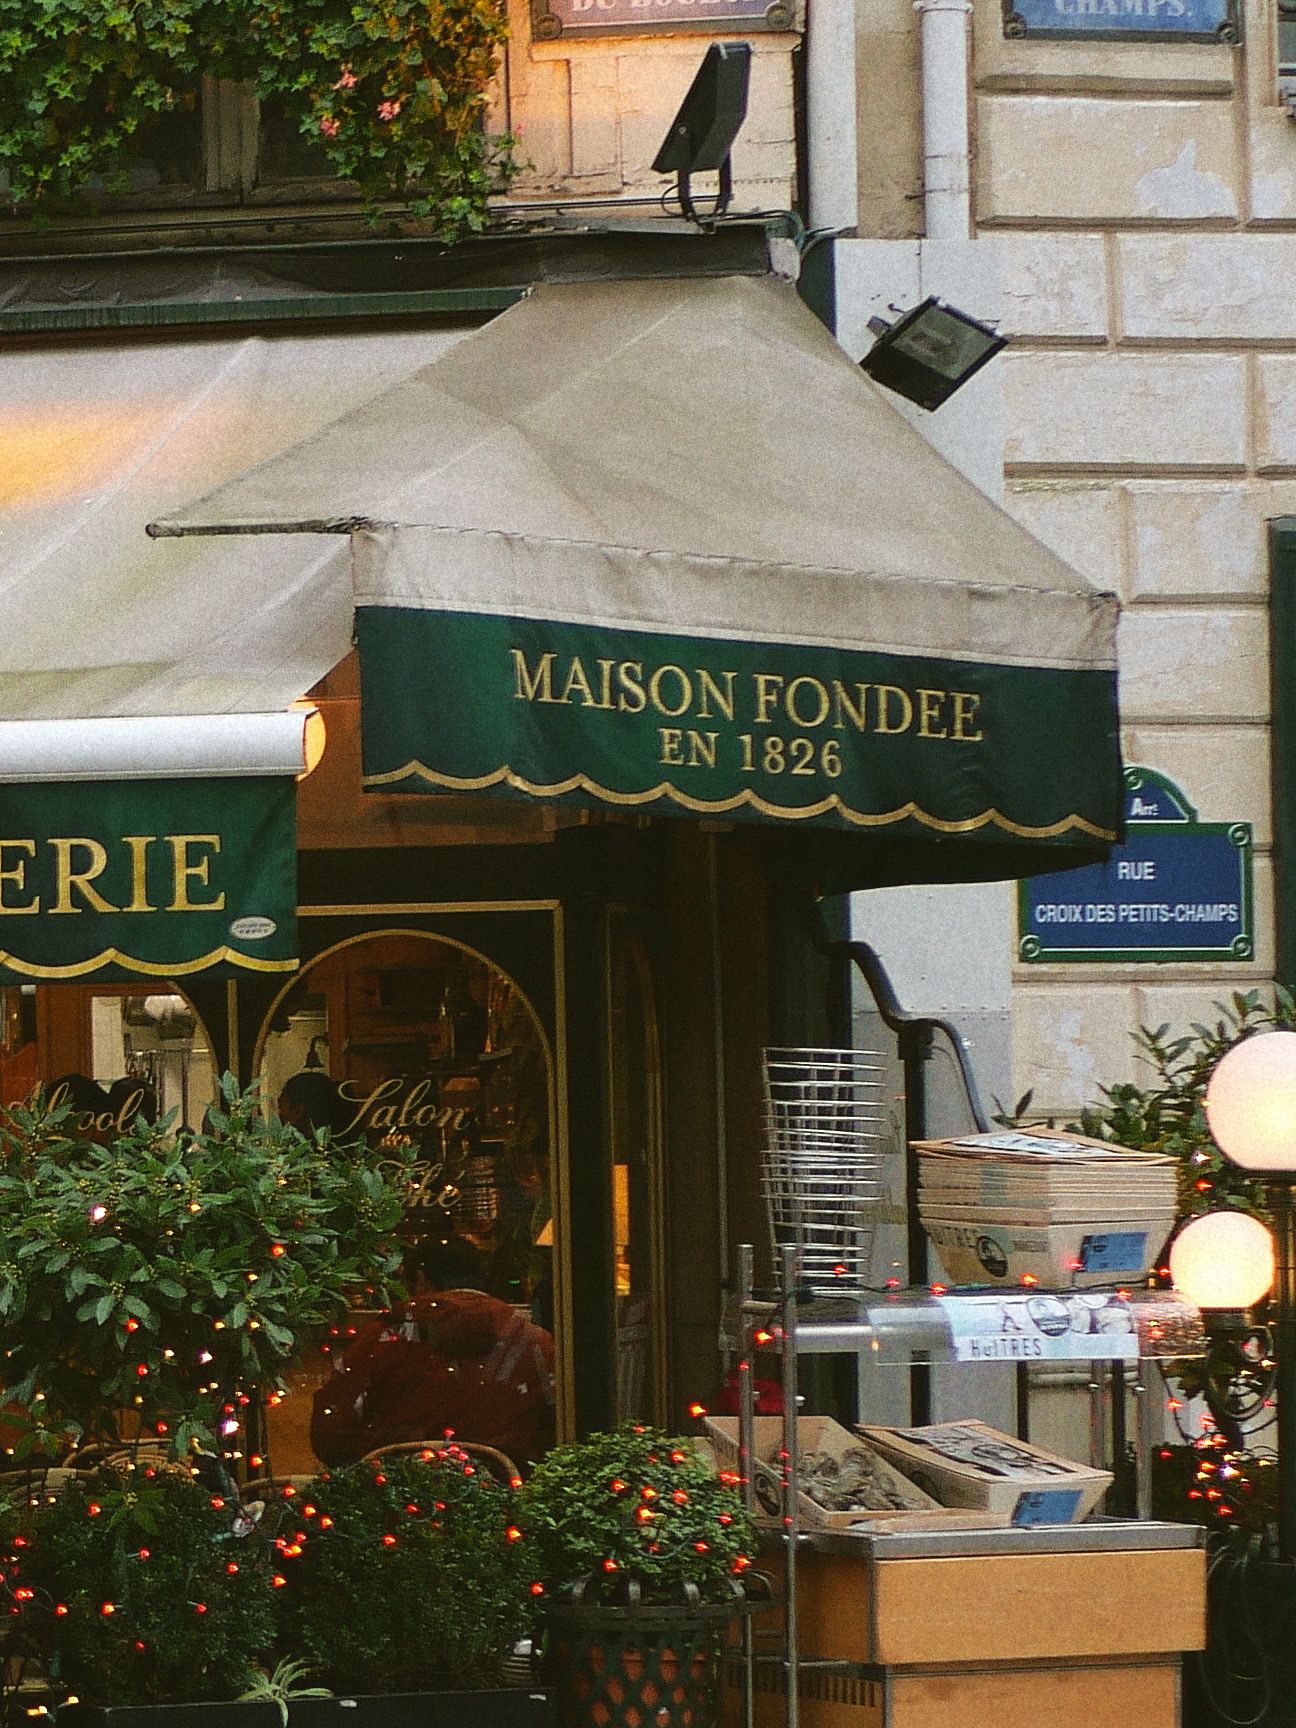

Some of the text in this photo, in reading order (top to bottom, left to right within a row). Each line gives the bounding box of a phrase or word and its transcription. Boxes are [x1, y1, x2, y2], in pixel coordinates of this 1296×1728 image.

[510, 647, 985, 743] MAISON FONDEE
[656, 727, 843, 779] EN 1826
[1116, 860, 1157, 881] RUE
[1035, 902, 1241, 923] CROIX DES PETITS-CHAMPS
[329, 1078, 471, 1139] Salon
